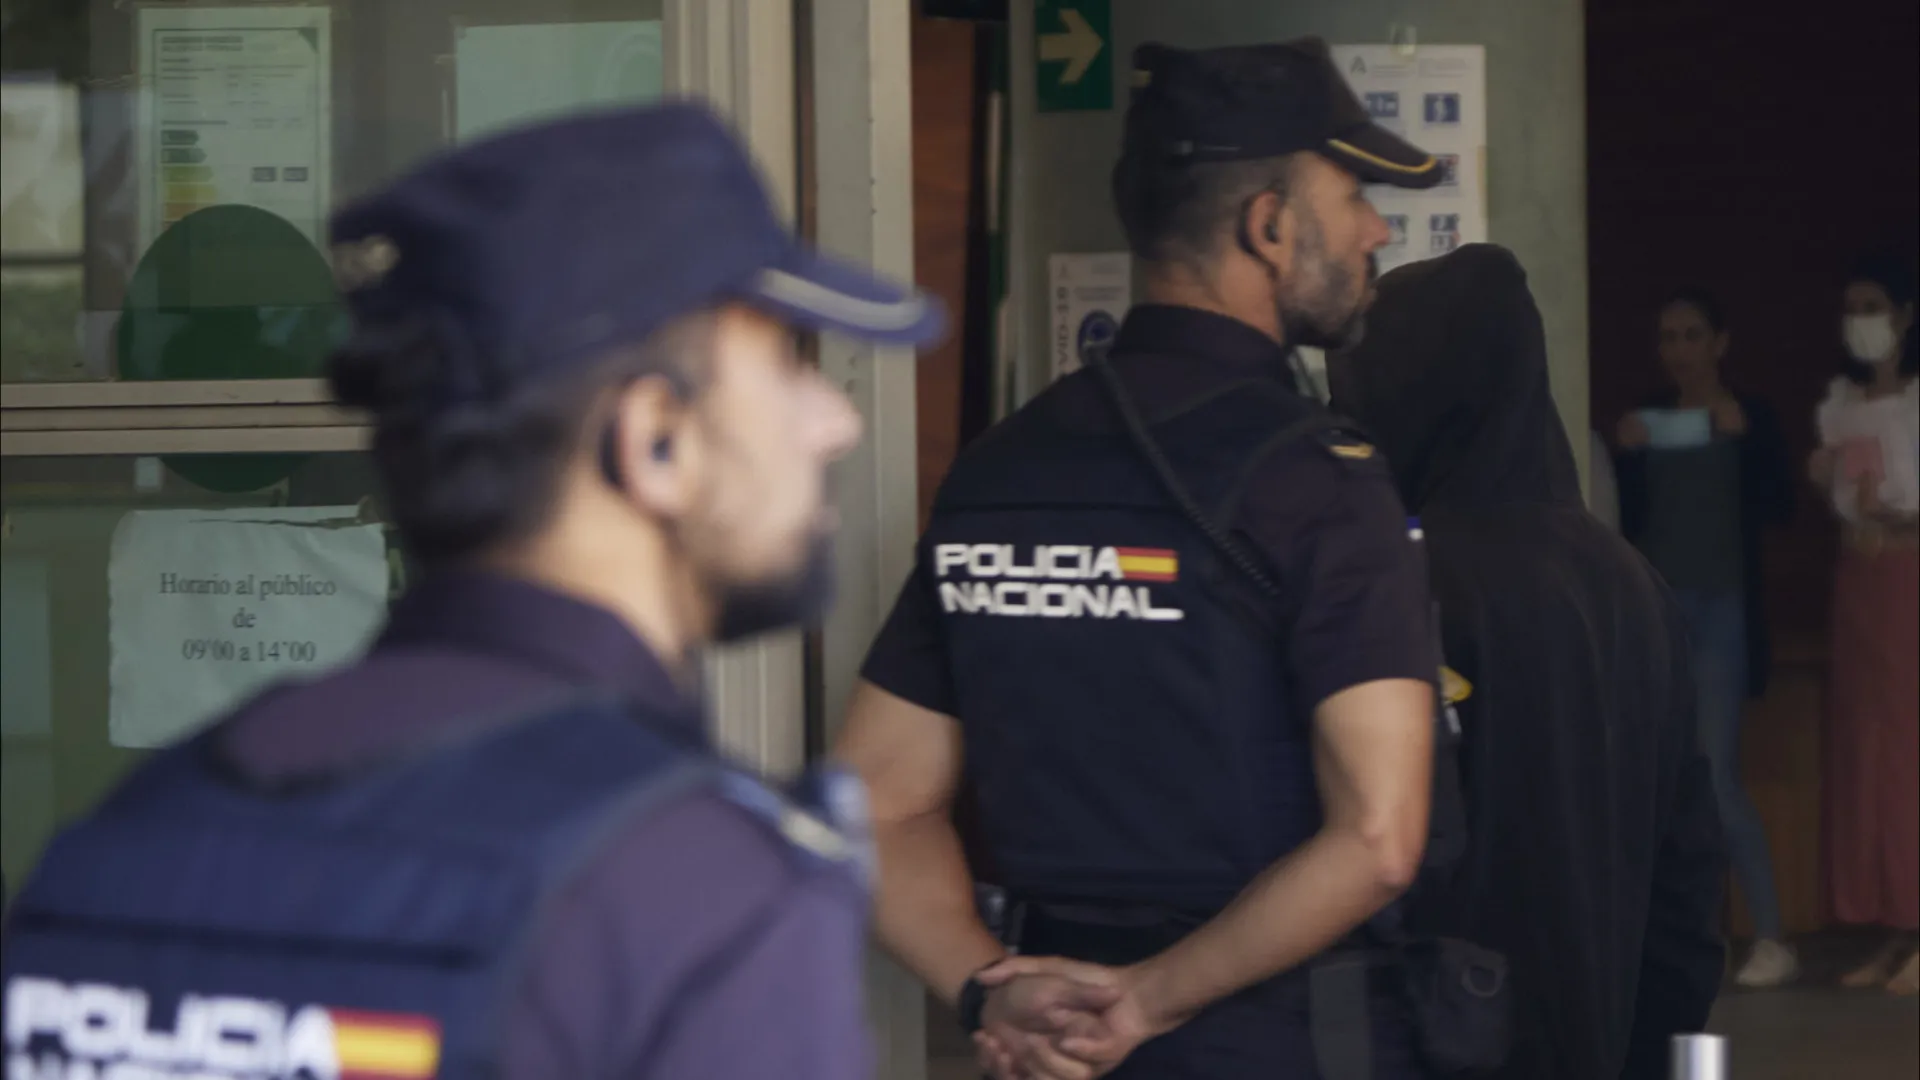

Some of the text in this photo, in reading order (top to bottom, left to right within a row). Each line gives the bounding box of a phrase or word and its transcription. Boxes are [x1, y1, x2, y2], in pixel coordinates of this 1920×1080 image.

[1056, 286, 1070, 367] VID-19
[934, 544, 1124, 579] POLICIA
[158, 572, 337, 601] Horario al público
[939, 581, 1184, 621] NACIONAL
[231, 606, 257, 629] de
[239, 646, 251, 663] a
